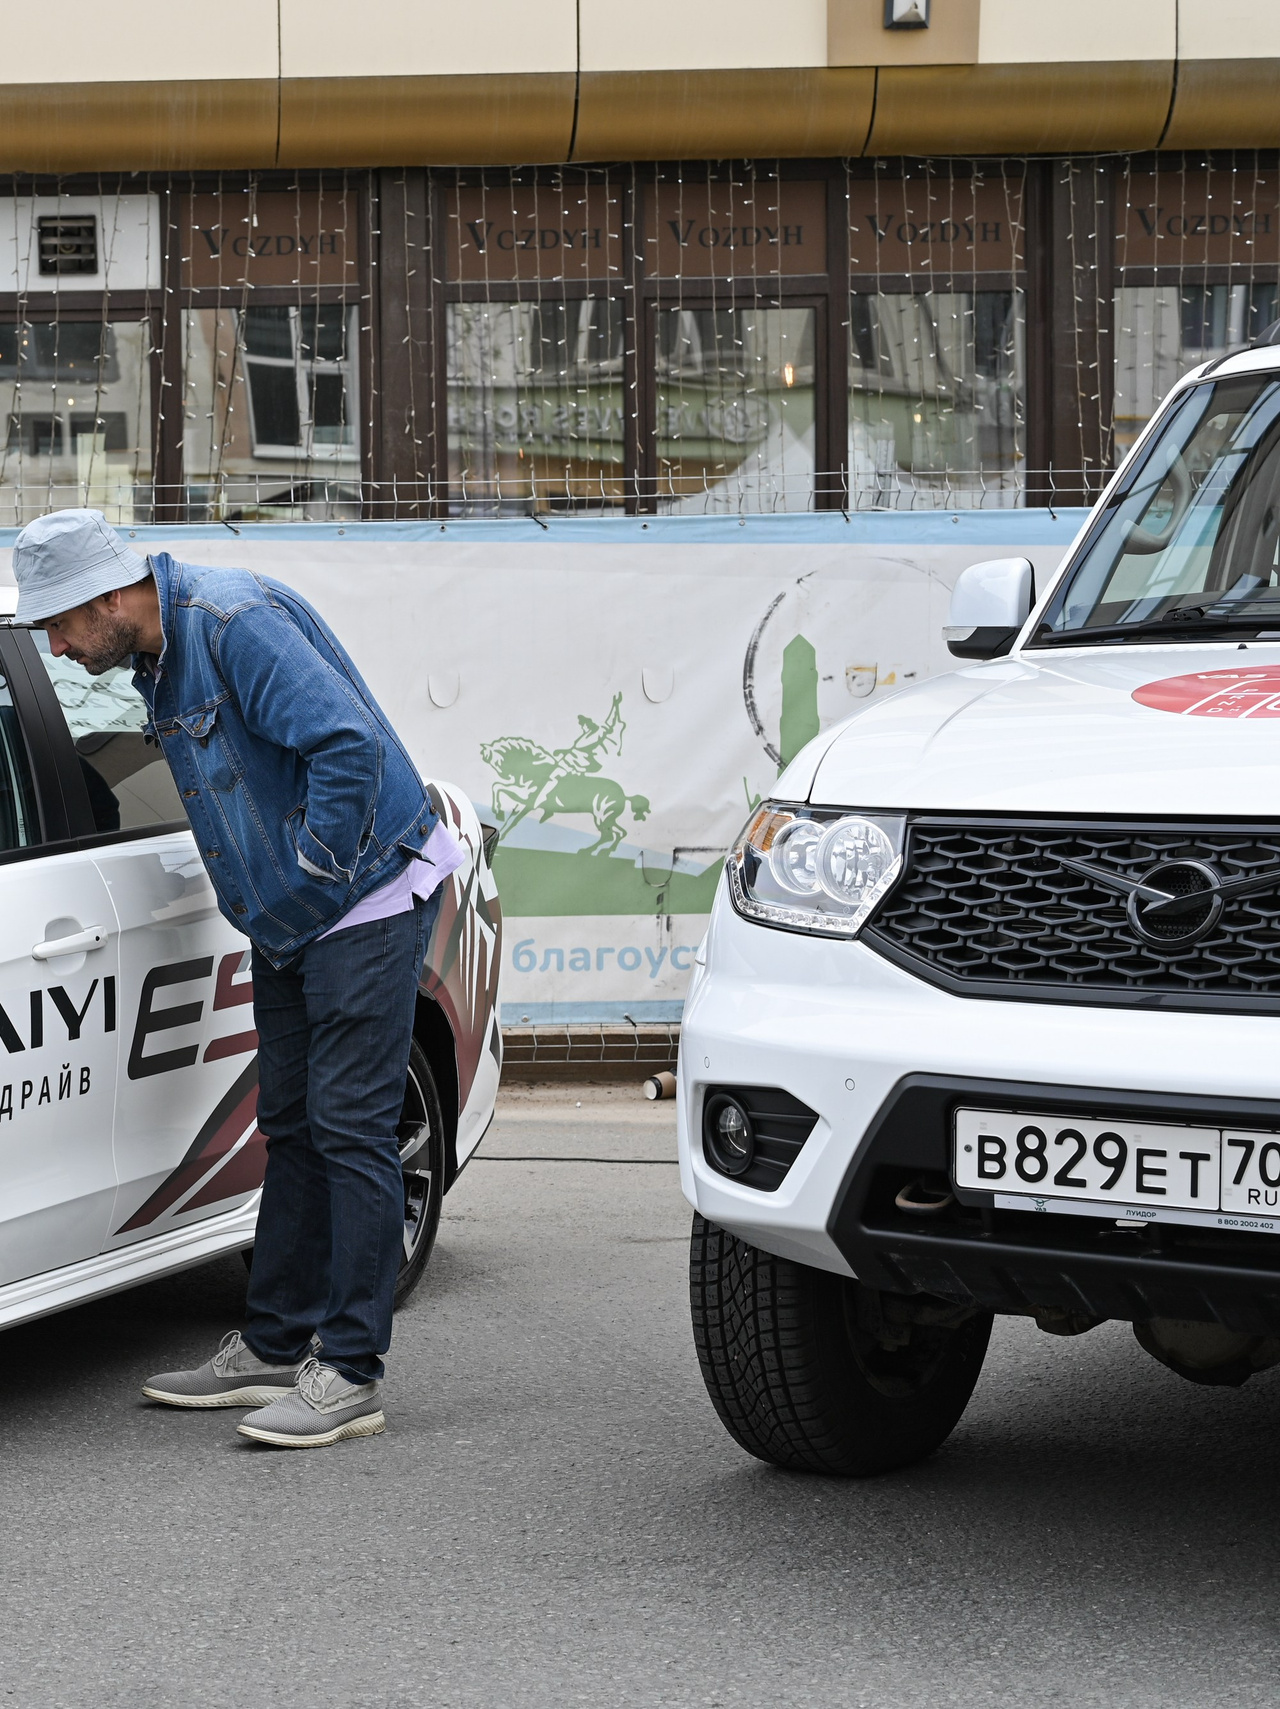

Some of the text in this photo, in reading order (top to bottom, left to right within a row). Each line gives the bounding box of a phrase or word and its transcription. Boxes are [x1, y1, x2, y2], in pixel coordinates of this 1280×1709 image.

[667, 218, 803, 248] VOZDYH
[865, 214, 1002, 244] VOZDYH
[1136, 207, 1272, 237] VOZDYH
[201, 228, 338, 259] VOZDYH
[1227, 1138, 1280, 1188] 70
[1125, 1209, 1157, 1218] ЛУИДОР
[1239, 1220, 1259, 1228] 2002
